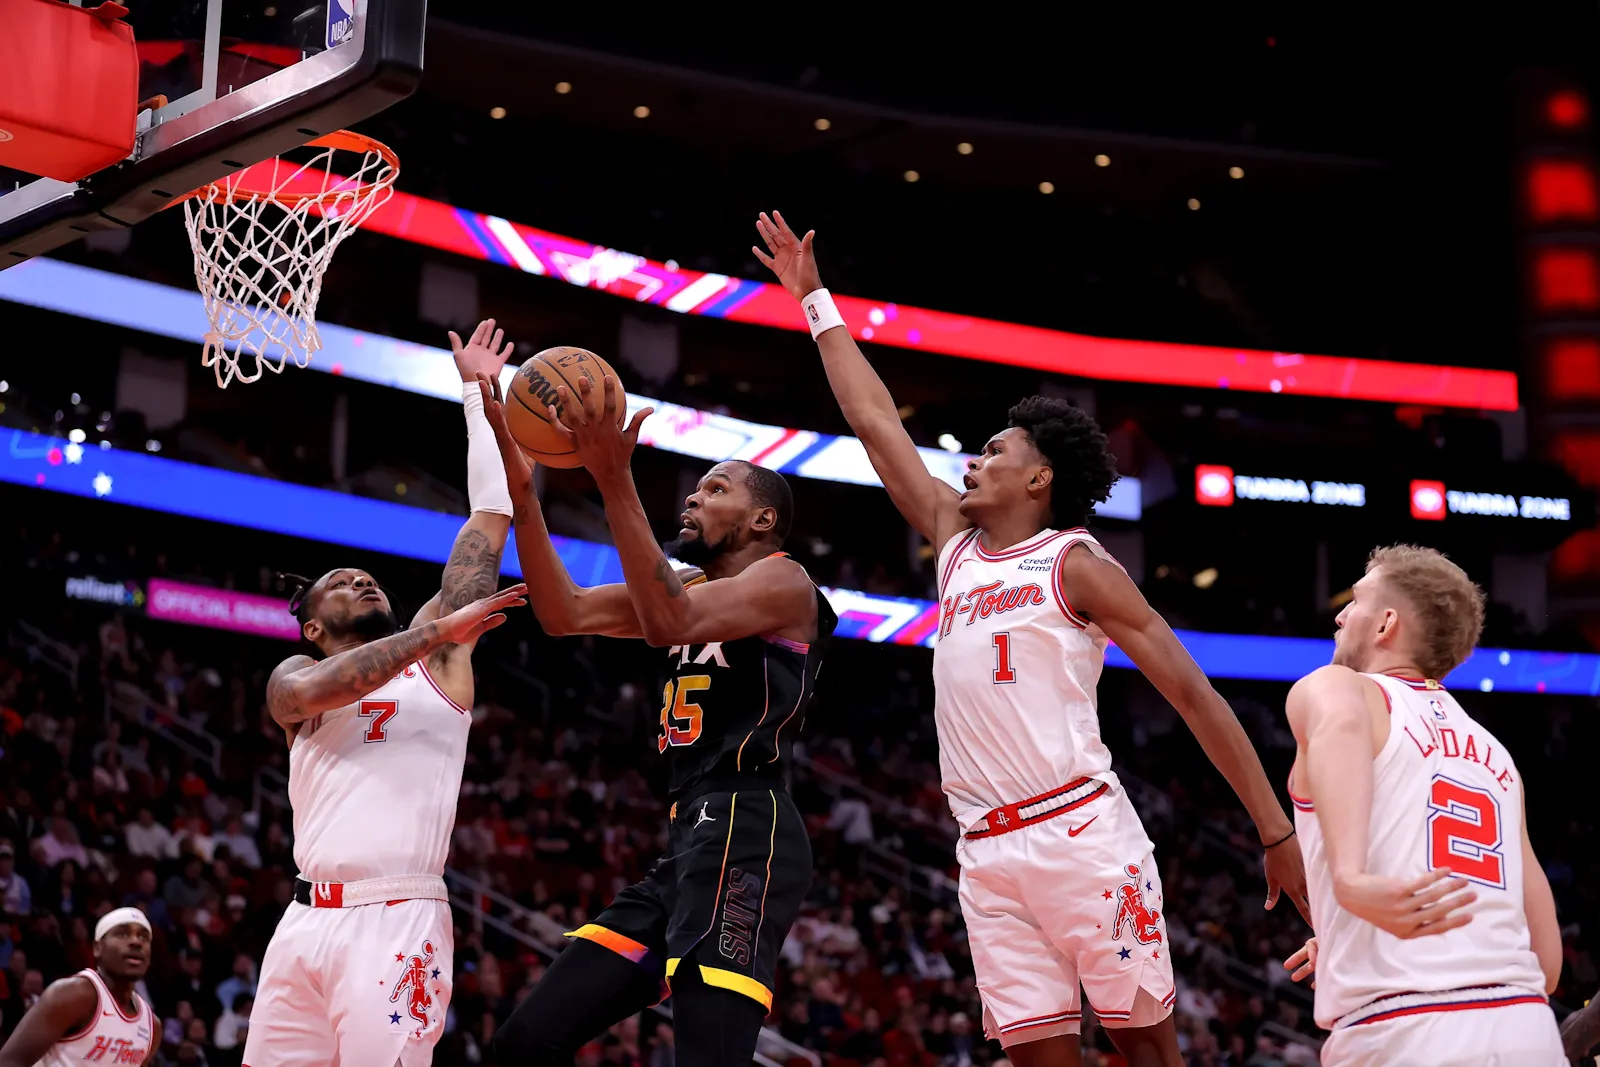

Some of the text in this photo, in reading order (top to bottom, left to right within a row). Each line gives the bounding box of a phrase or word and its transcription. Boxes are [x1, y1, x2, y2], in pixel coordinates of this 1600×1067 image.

[1233, 475, 1366, 507] TUNDRA ZONE
[1446, 490, 1571, 521] TUNDRA ZONE
[1017, 563, 1052, 572] karma
[1023, 556, 1055, 565] credit
[154, 588, 231, 621] OFFICIAL
[938, 580, 1046, 642] H-Town
[992, 632, 1016, 684] 1
[358, 698, 399, 743] 7
[1404, 715, 1514, 792] LDALE
[1427, 773, 1507, 891] 2
[719, 867, 761, 966] SUNS
